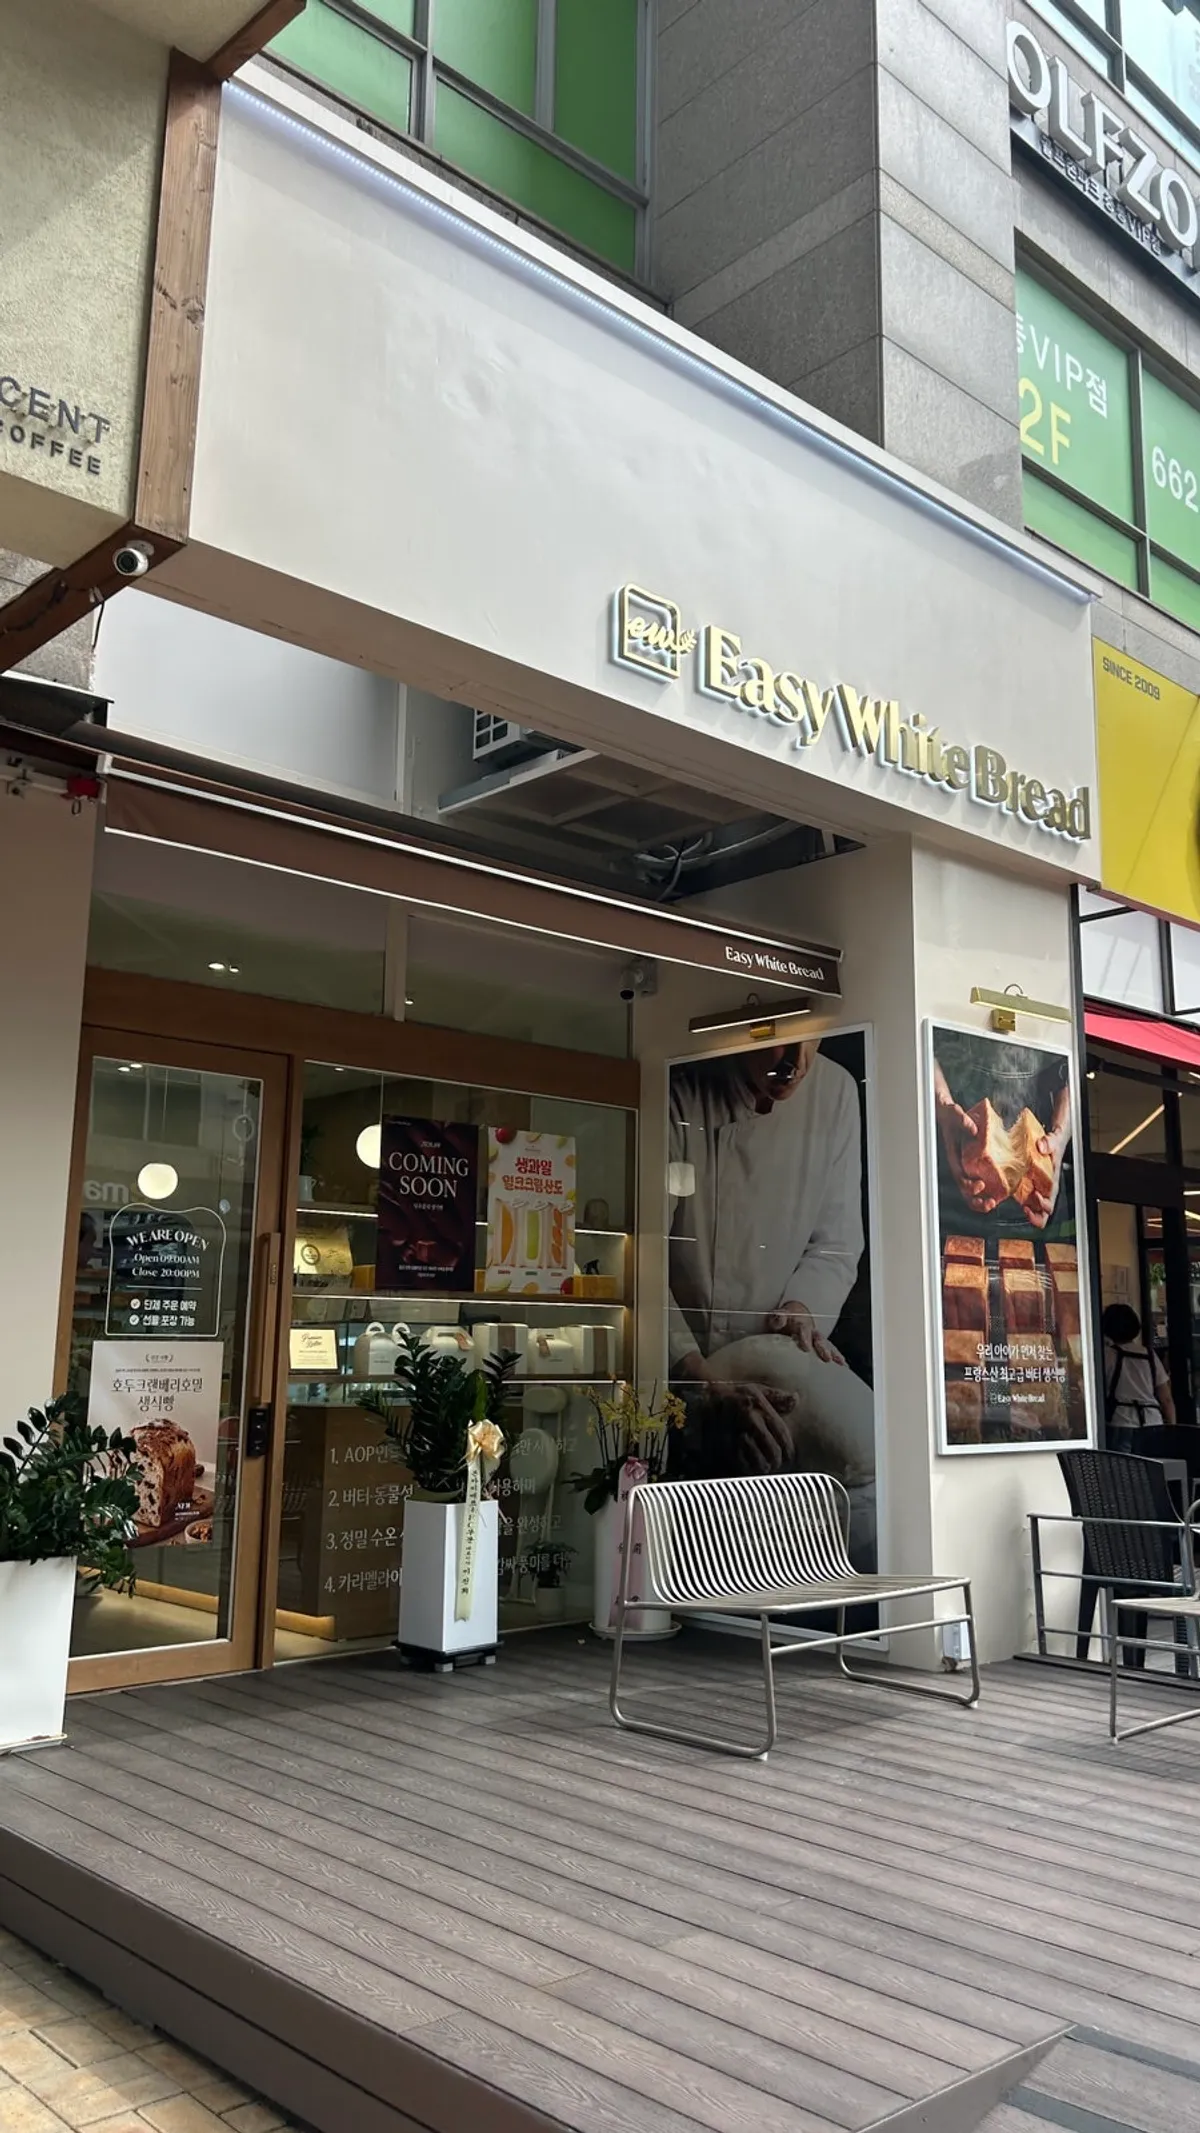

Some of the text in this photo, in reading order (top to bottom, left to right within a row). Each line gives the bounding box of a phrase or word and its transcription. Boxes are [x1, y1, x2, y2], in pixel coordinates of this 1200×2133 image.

[1018, 377, 1072, 466] 2F
[1102, 656, 1160, 701] SINCE 2009
[704, 624, 1091, 842] Easy White Bread
[724, 946, 825, 981] Easy White Bread
[388, 1151, 470, 1177] COMING
[514, 1156, 553, 1177] 생과일
[399, 1175, 459, 1199] SOON
[126, 1228, 210, 1252] WE ARE OPEN
[133, 1253, 159, 1264] Open
[132, 1267, 158, 1278] Close
[162, 1299, 179, 1311] 주문
[976, 1343, 993, 1359] 우리
[994, 1343, 1019, 1360] 아이가
[964, 1366, 999, 1383] 프랑스산
[999, 1366, 1024, 1383] 최고급
[137, 1394, 176, 1412] 생식빵
[330, 1448, 339, 1464] 1.
[328, 1489, 341, 1507] 2.
[325, 1533, 339, 1550] 3.
[340, 1529, 368, 1551] 정밀
[370, 1527, 397, 1548] 수온
[324, 1576, 337, 1594] 4.
